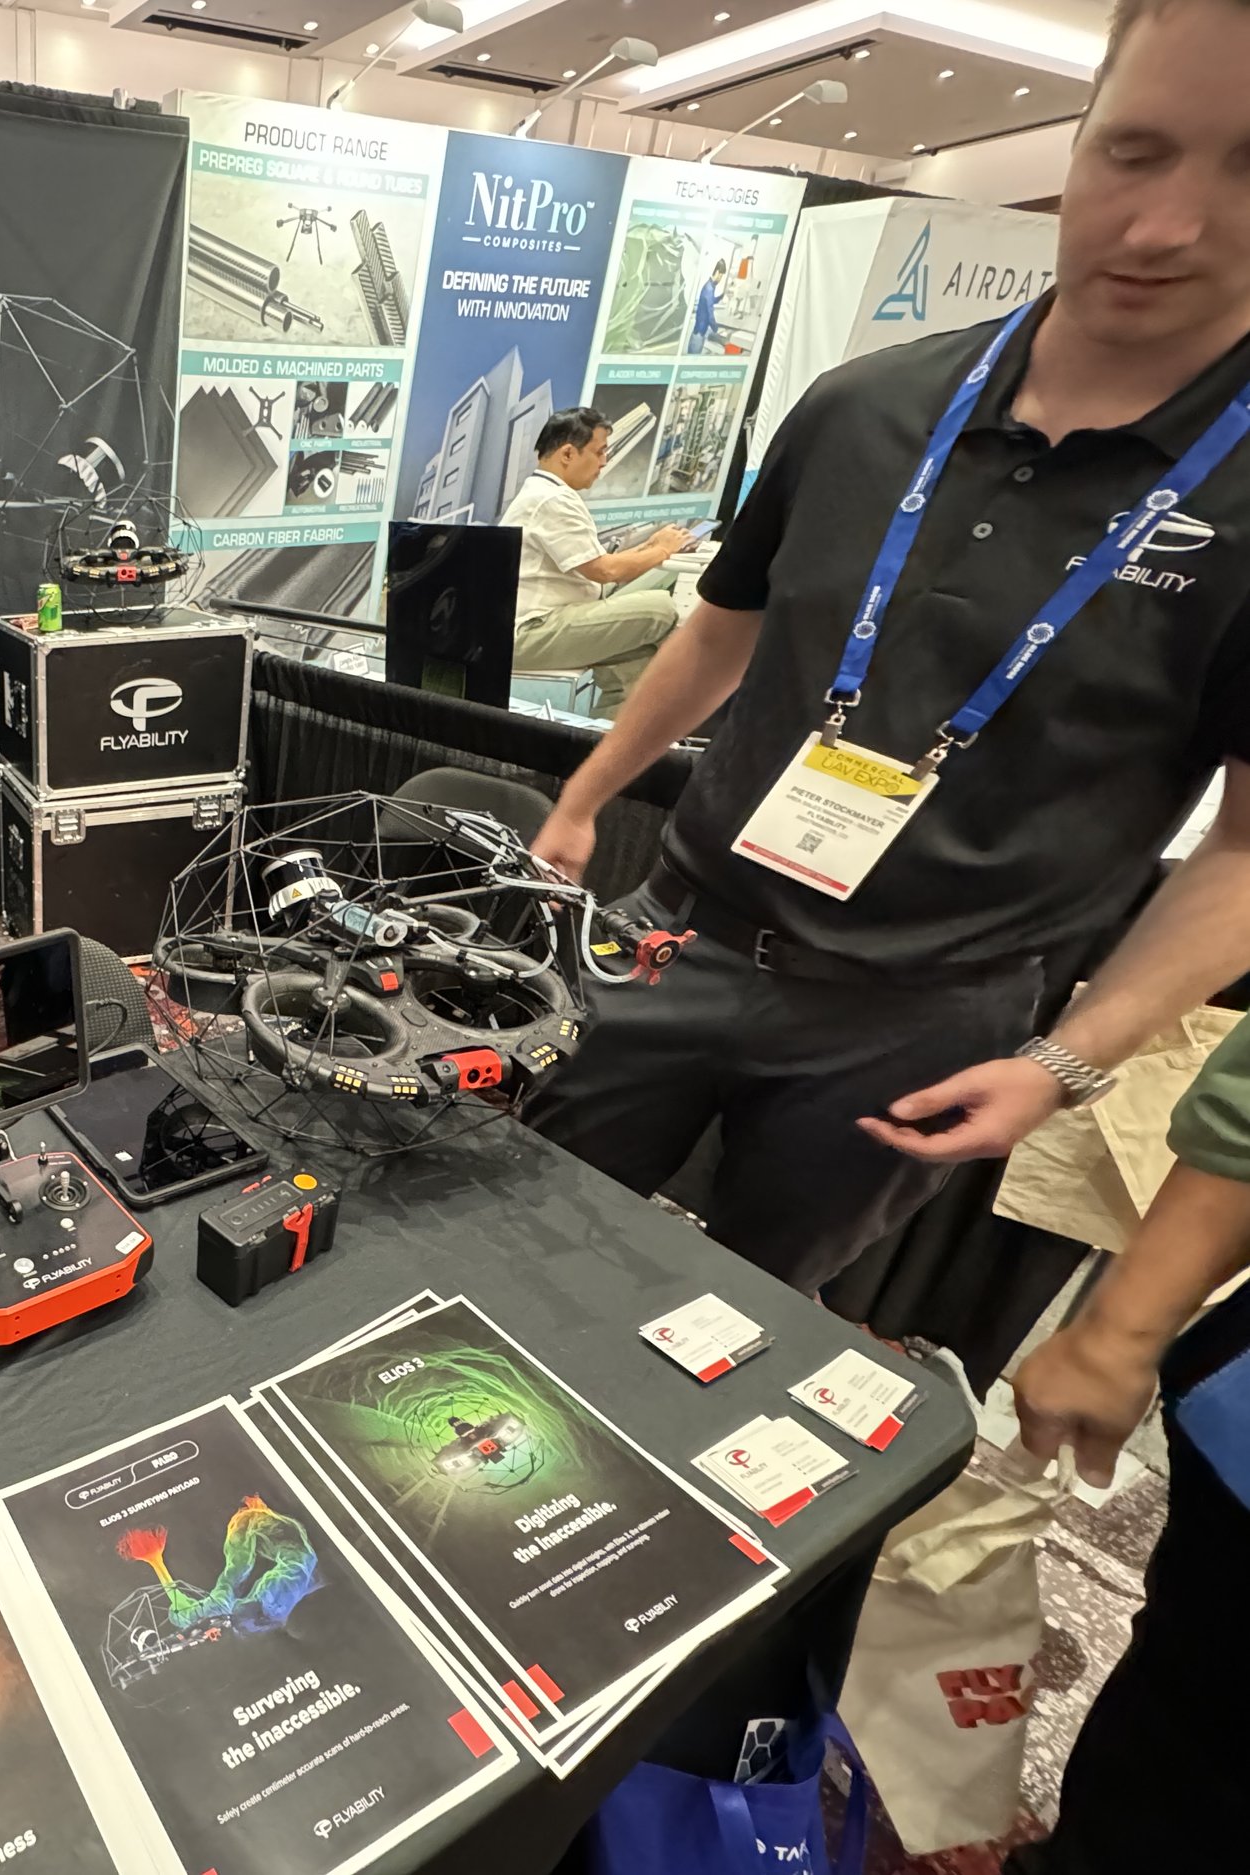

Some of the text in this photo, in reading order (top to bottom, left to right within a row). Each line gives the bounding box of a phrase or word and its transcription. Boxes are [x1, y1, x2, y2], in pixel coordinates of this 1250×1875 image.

[244, 121, 389, 162] PRODUCT RANGE
[199, 150, 264, 176] PREPREG
[385, 175, 423, 195] TUBES
[675, 178, 760, 207] TECHNOLOGIES
[482, 234, 563, 254] COMPOSITES
[442, 269, 591, 299] DEFINING THE FUTURE
[456, 298, 571, 322] WITH INNOVATION
[203, 356, 385, 378] MOLDED & MACHINED PARTS
[213, 528, 344, 548] CARBON FIBER FABRIC
[100, 729, 189, 751] FLYABILITY
[821, 756, 901, 794] UAV EXPO
[828, 750, 905, 785] COMMERCIAL
[790, 785, 823, 806] PIETER
[822, 797, 886, 830] STOCKMAYER
[41, 1257, 93, 1284] FLYABILITY
[377, 1356, 425, 1385] ELIOS 3
[90, 1476, 122, 1496] FLYABILITY
[99, 1476, 200, 1528] ELIOS 3 SURVEYING PAYLOAD
[513, 1544, 542, 1565] the
[638, 1594, 679, 1626] FLYABILITY
[232, 1669, 321, 1727] Surveying
[221, 1681, 361, 1769] the inaccessible.
[217, 1805, 241, 1825] Safely
[239, 1792, 263, 1812] create
[261, 1771, 297, 1798] centimeter
[295, 1754, 325, 1777] accurate
[323, 1743, 344, 1760] scans
[342, 1736, 351, 1749] of
[348, 1713, 392, 1743] hard-to-reach
[332, 1785, 386, 1828] FLYABILITY
